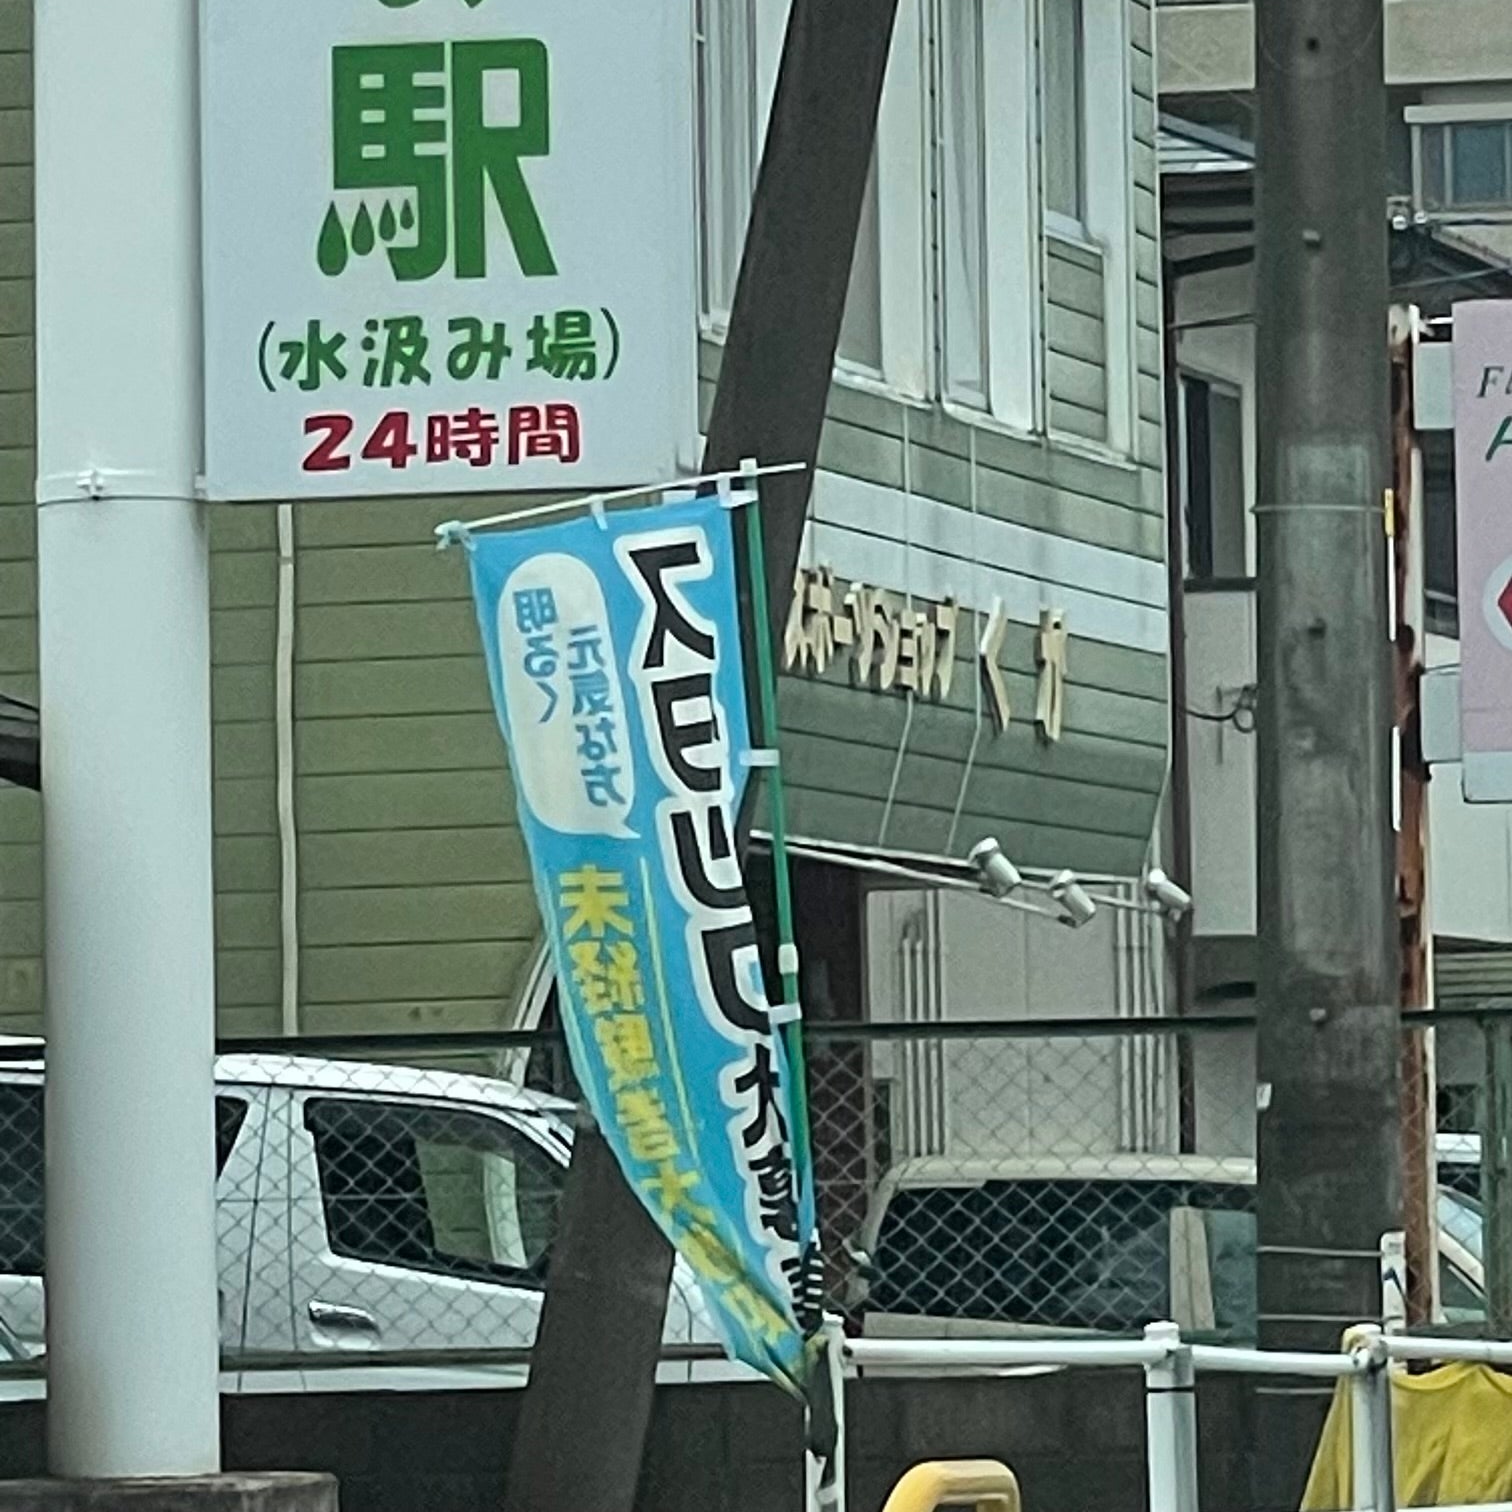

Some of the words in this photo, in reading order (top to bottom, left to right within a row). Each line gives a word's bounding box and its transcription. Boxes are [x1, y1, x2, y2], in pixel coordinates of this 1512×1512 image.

[258, 307, 621, 392] (水汲み場)
[301, 402, 580, 472] 24時間
